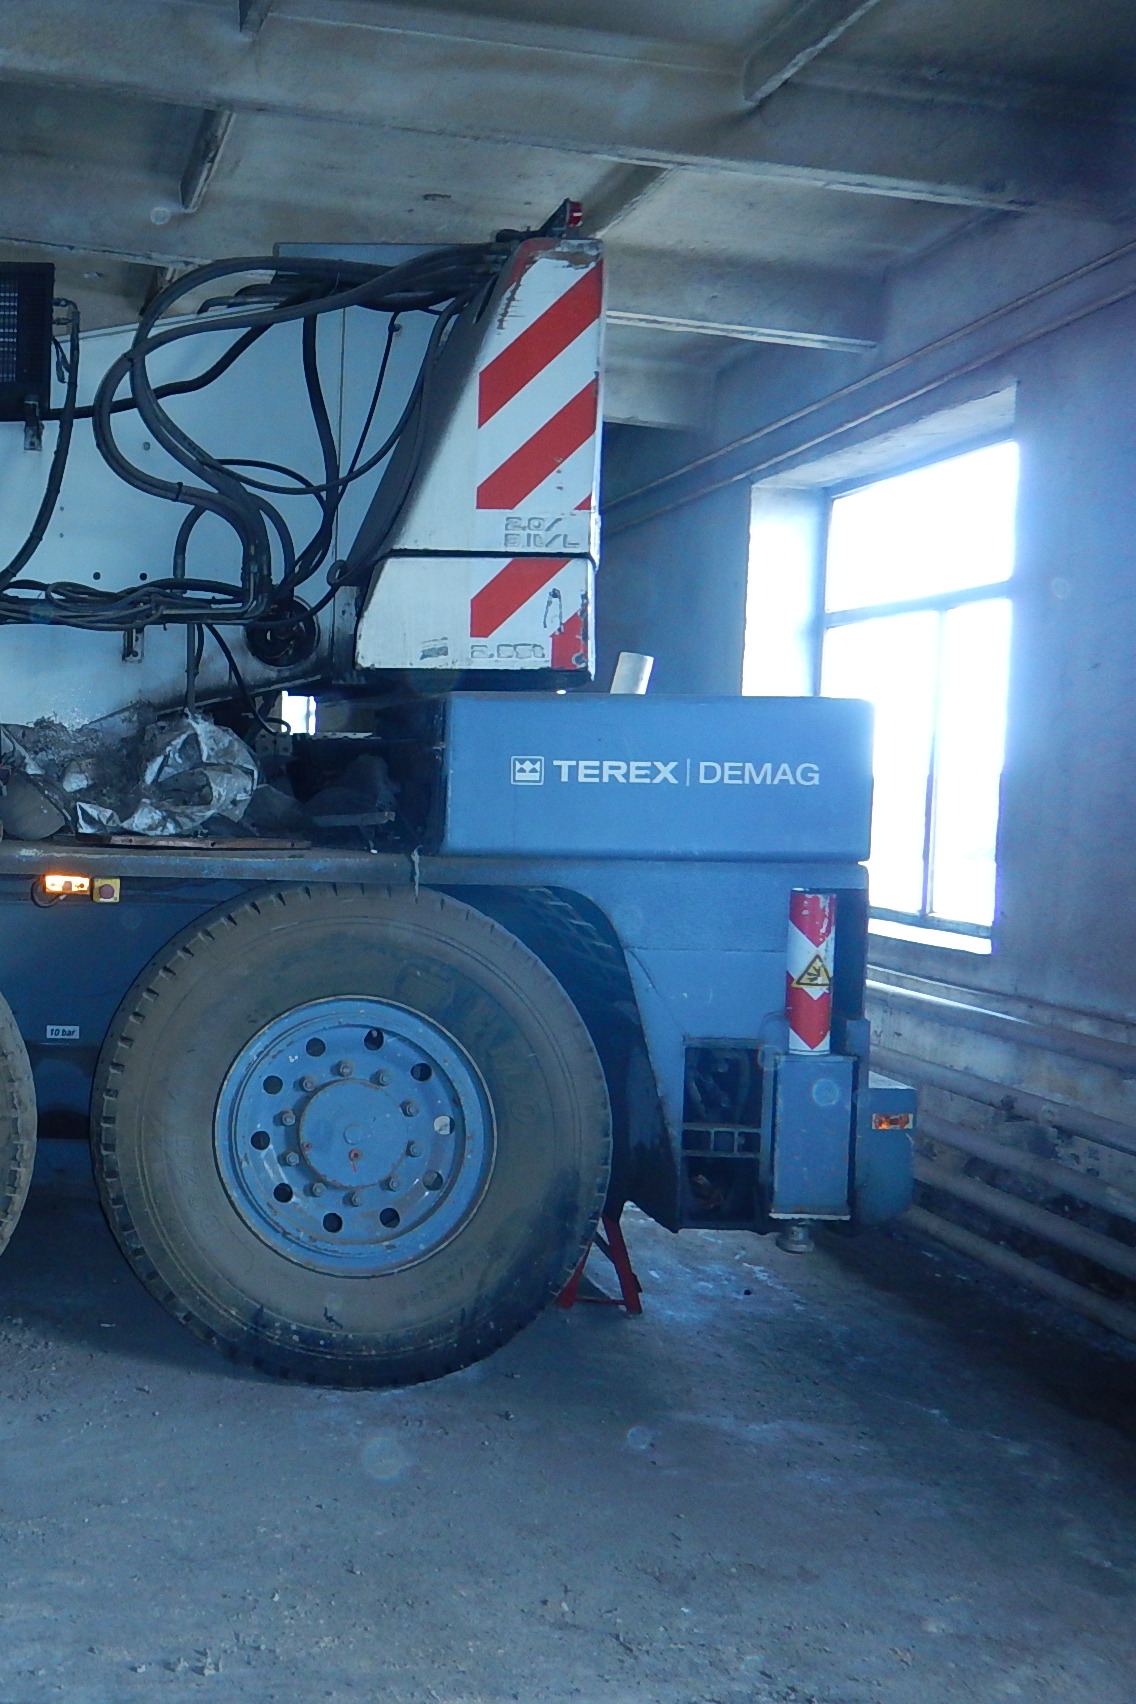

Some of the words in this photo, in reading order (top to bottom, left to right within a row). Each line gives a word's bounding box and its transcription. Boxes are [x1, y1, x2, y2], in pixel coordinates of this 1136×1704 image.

[552, 760, 679, 784] TEREX
[699, 761, 820, 786] DEMAG
[50, 1028, 60, 1037] 10
[61, 1028, 76, 1037] bar
